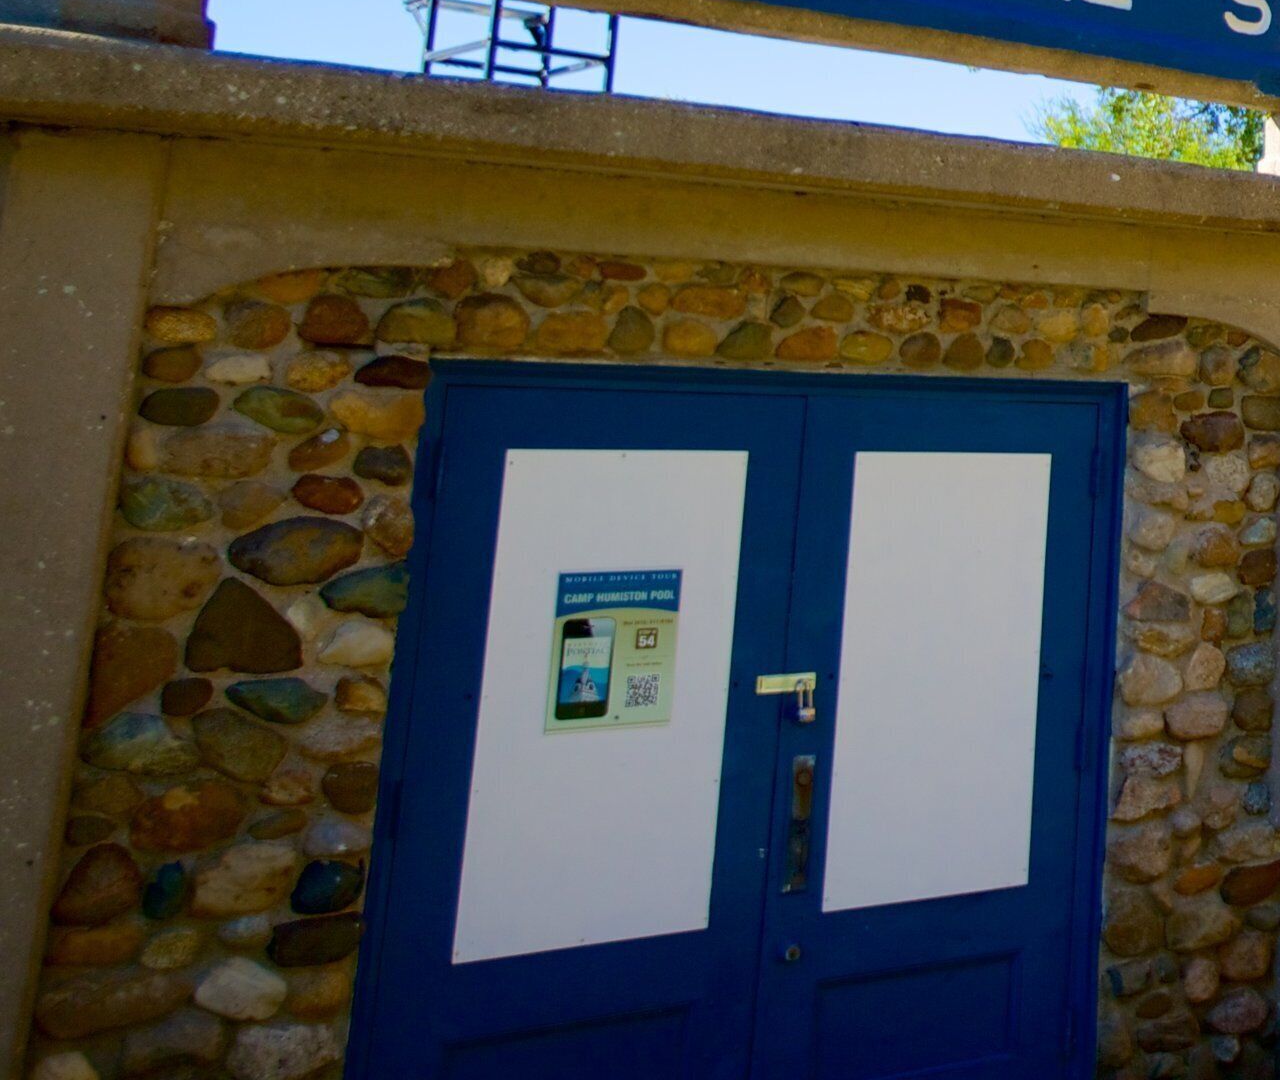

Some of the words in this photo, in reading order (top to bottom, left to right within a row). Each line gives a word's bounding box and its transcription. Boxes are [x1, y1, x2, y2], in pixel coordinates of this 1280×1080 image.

[564, 593, 594, 604] CAMP
[596, 591, 647, 602] HUMISTON
[650, 589, 675, 600] POOL
[638, 635, 655, 647] 54
